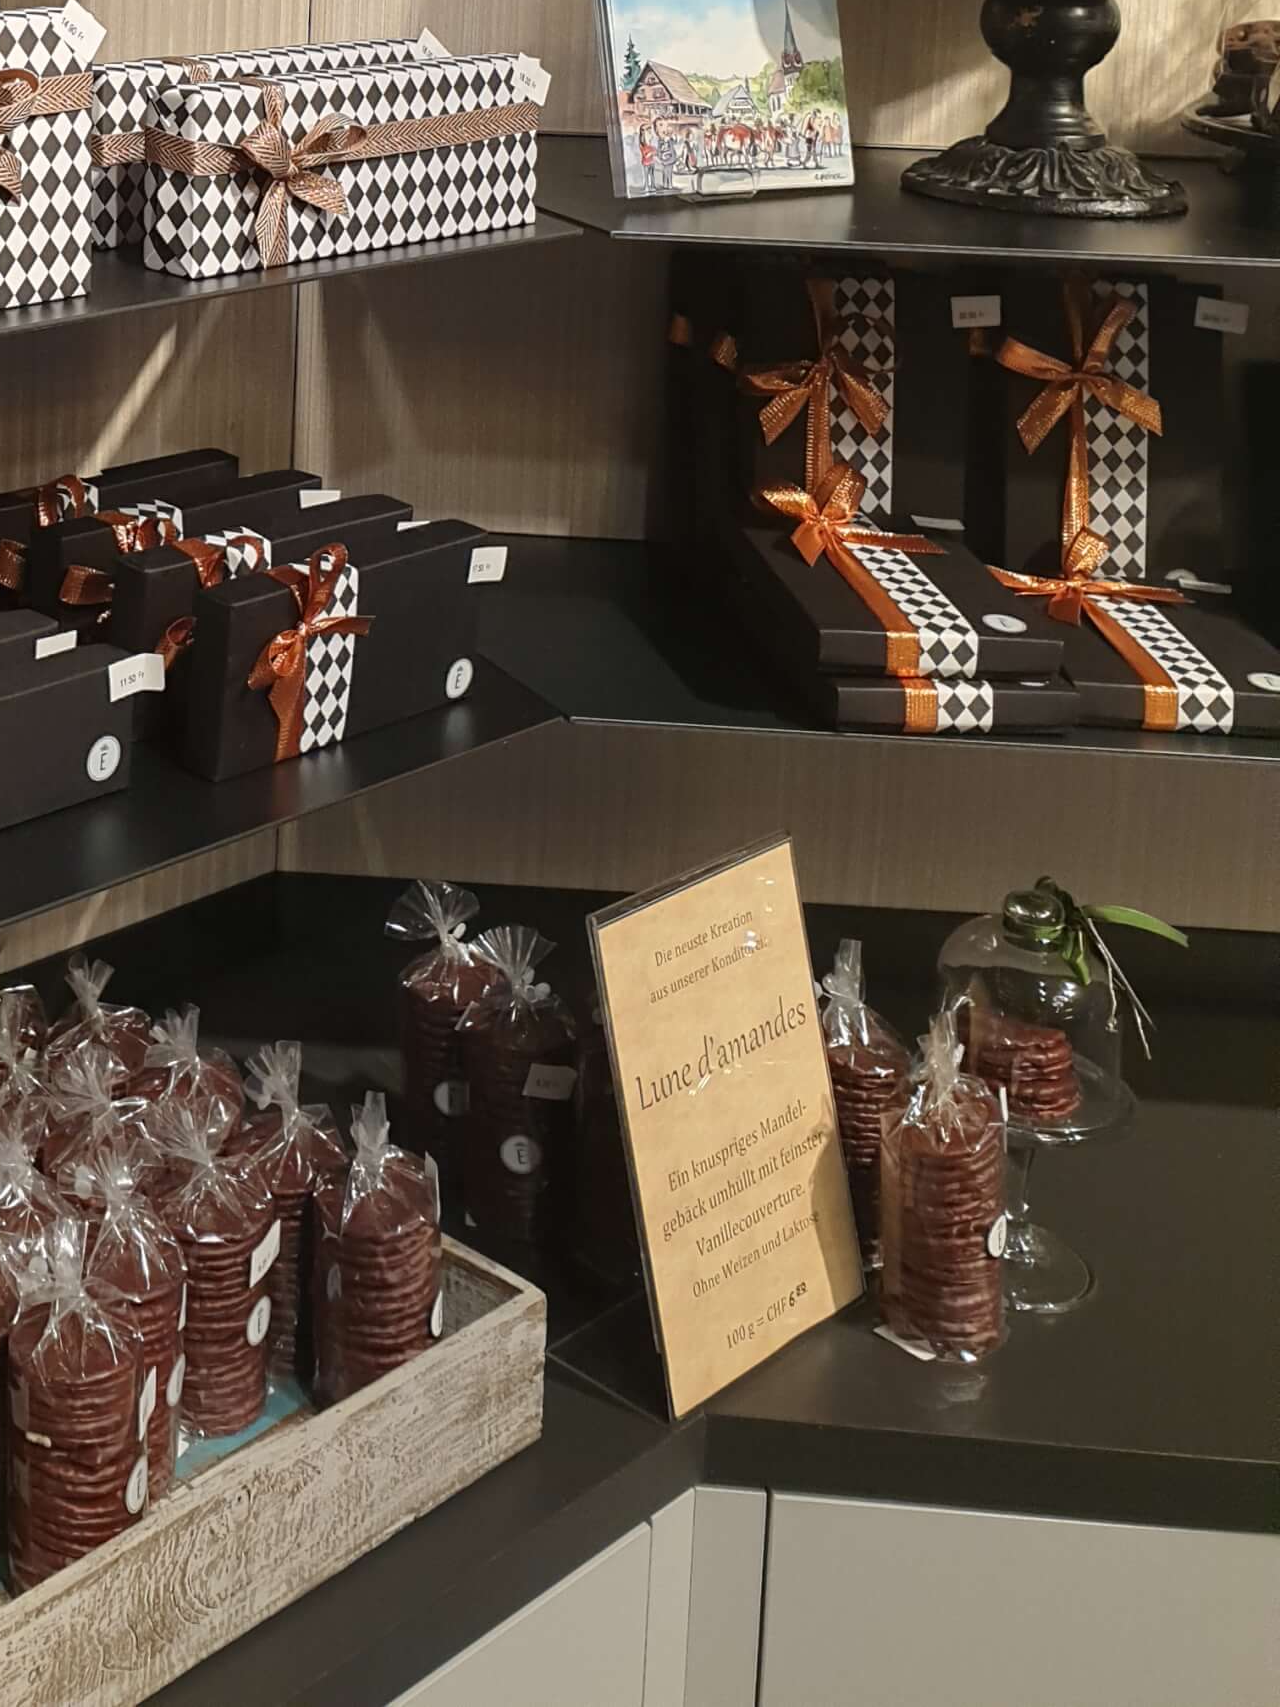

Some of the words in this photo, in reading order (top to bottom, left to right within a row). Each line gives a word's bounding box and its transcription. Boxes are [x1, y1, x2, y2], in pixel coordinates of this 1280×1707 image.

[654, 949, 673, 968] Die
[674, 932, 708, 956] neuste
[709, 911, 753, 940] Kreation
[649, 987, 669, 1005] aus
[670, 963, 710, 994] unserer
[634, 1062, 693, 1111] Lune
[698, 995, 808, 1077] d'amandes
[668, 1168, 690, 1192] Ein
[691, 1129, 759, 1178] knuspriges
[759, 1098, 808, 1139] Mandel-
[662, 1198, 707, 1242] gebäck
[708, 1171, 758, 1216] umhüllt
[758, 1159, 778, 1183] mit
[780, 1129, 825, 1168] feinster
[695, 1183, 806, 1257] Vanillecouverture.
[692, 1275, 721, 1298] Ohne
[721, 1249, 761, 1279] Weizen
[762, 1231, 782, 1256] und
[783, 1211, 820, 1243] Laktose
[726, 1324, 746, 1349] 100
[748, 1322, 755, 1340] g
[766, 1297, 787, 1322] CHF
